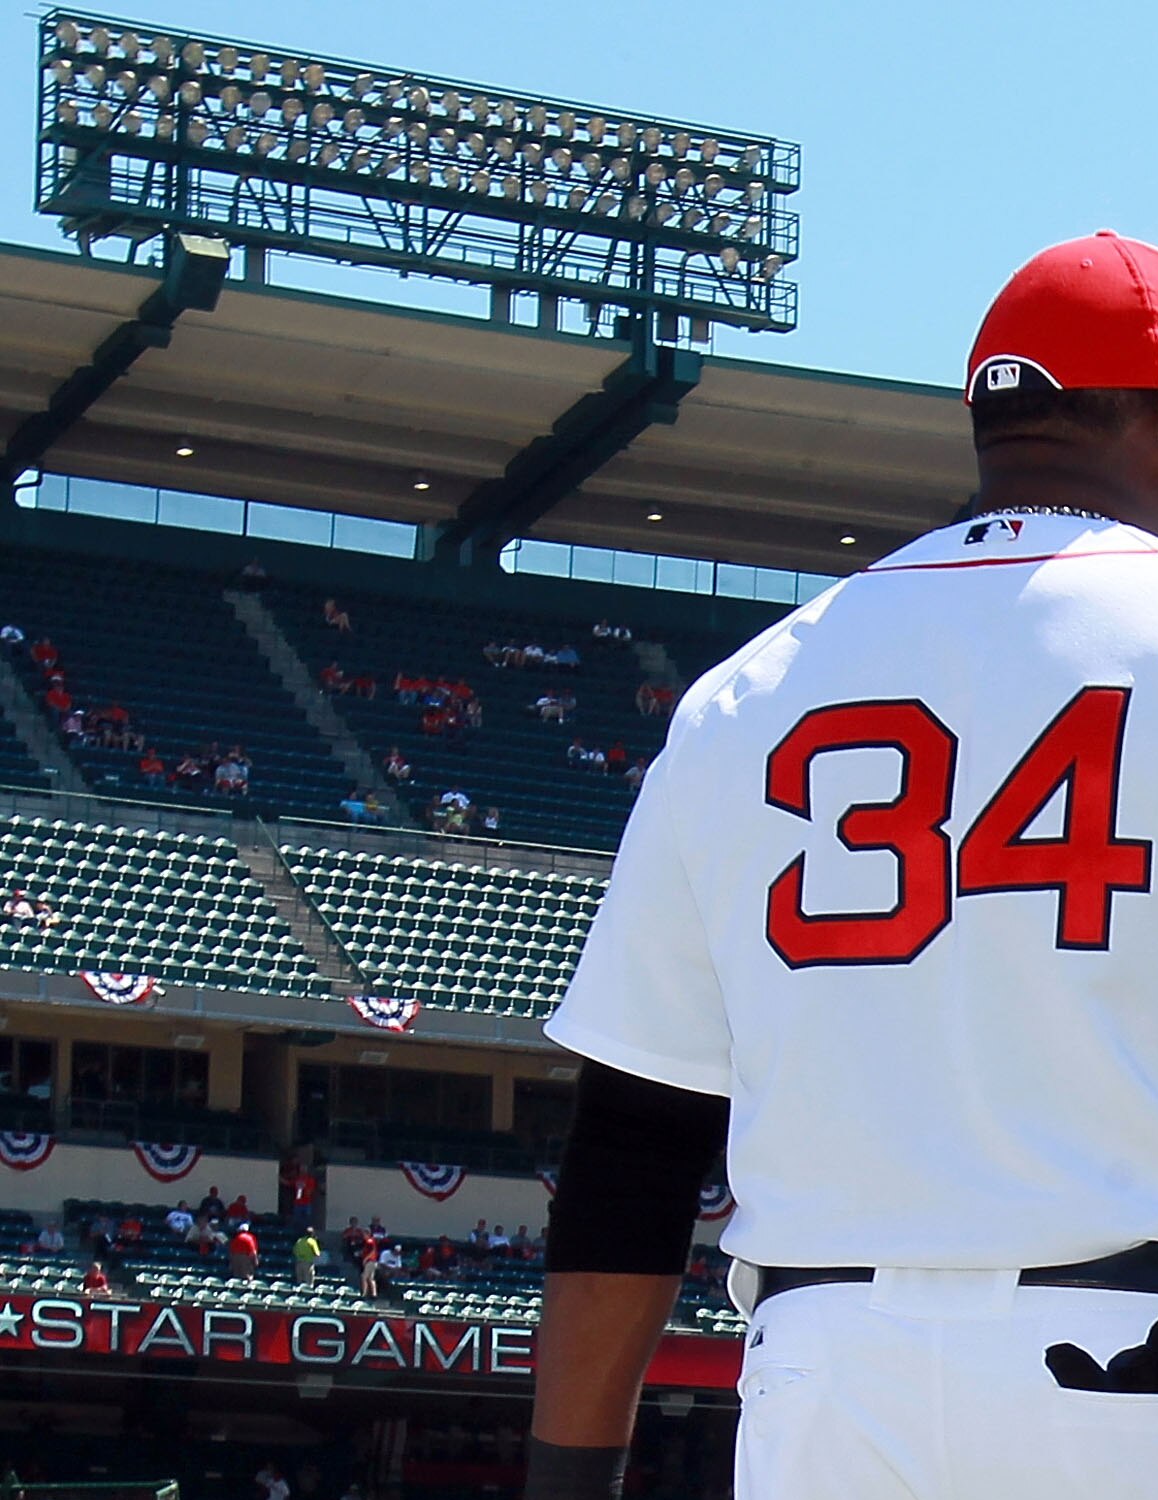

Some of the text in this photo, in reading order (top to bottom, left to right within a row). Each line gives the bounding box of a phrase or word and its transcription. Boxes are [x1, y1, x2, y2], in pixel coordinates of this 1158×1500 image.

[765, 686, 1154, 968] 34
[31, 1299, 534, 1375] STAR GAME
